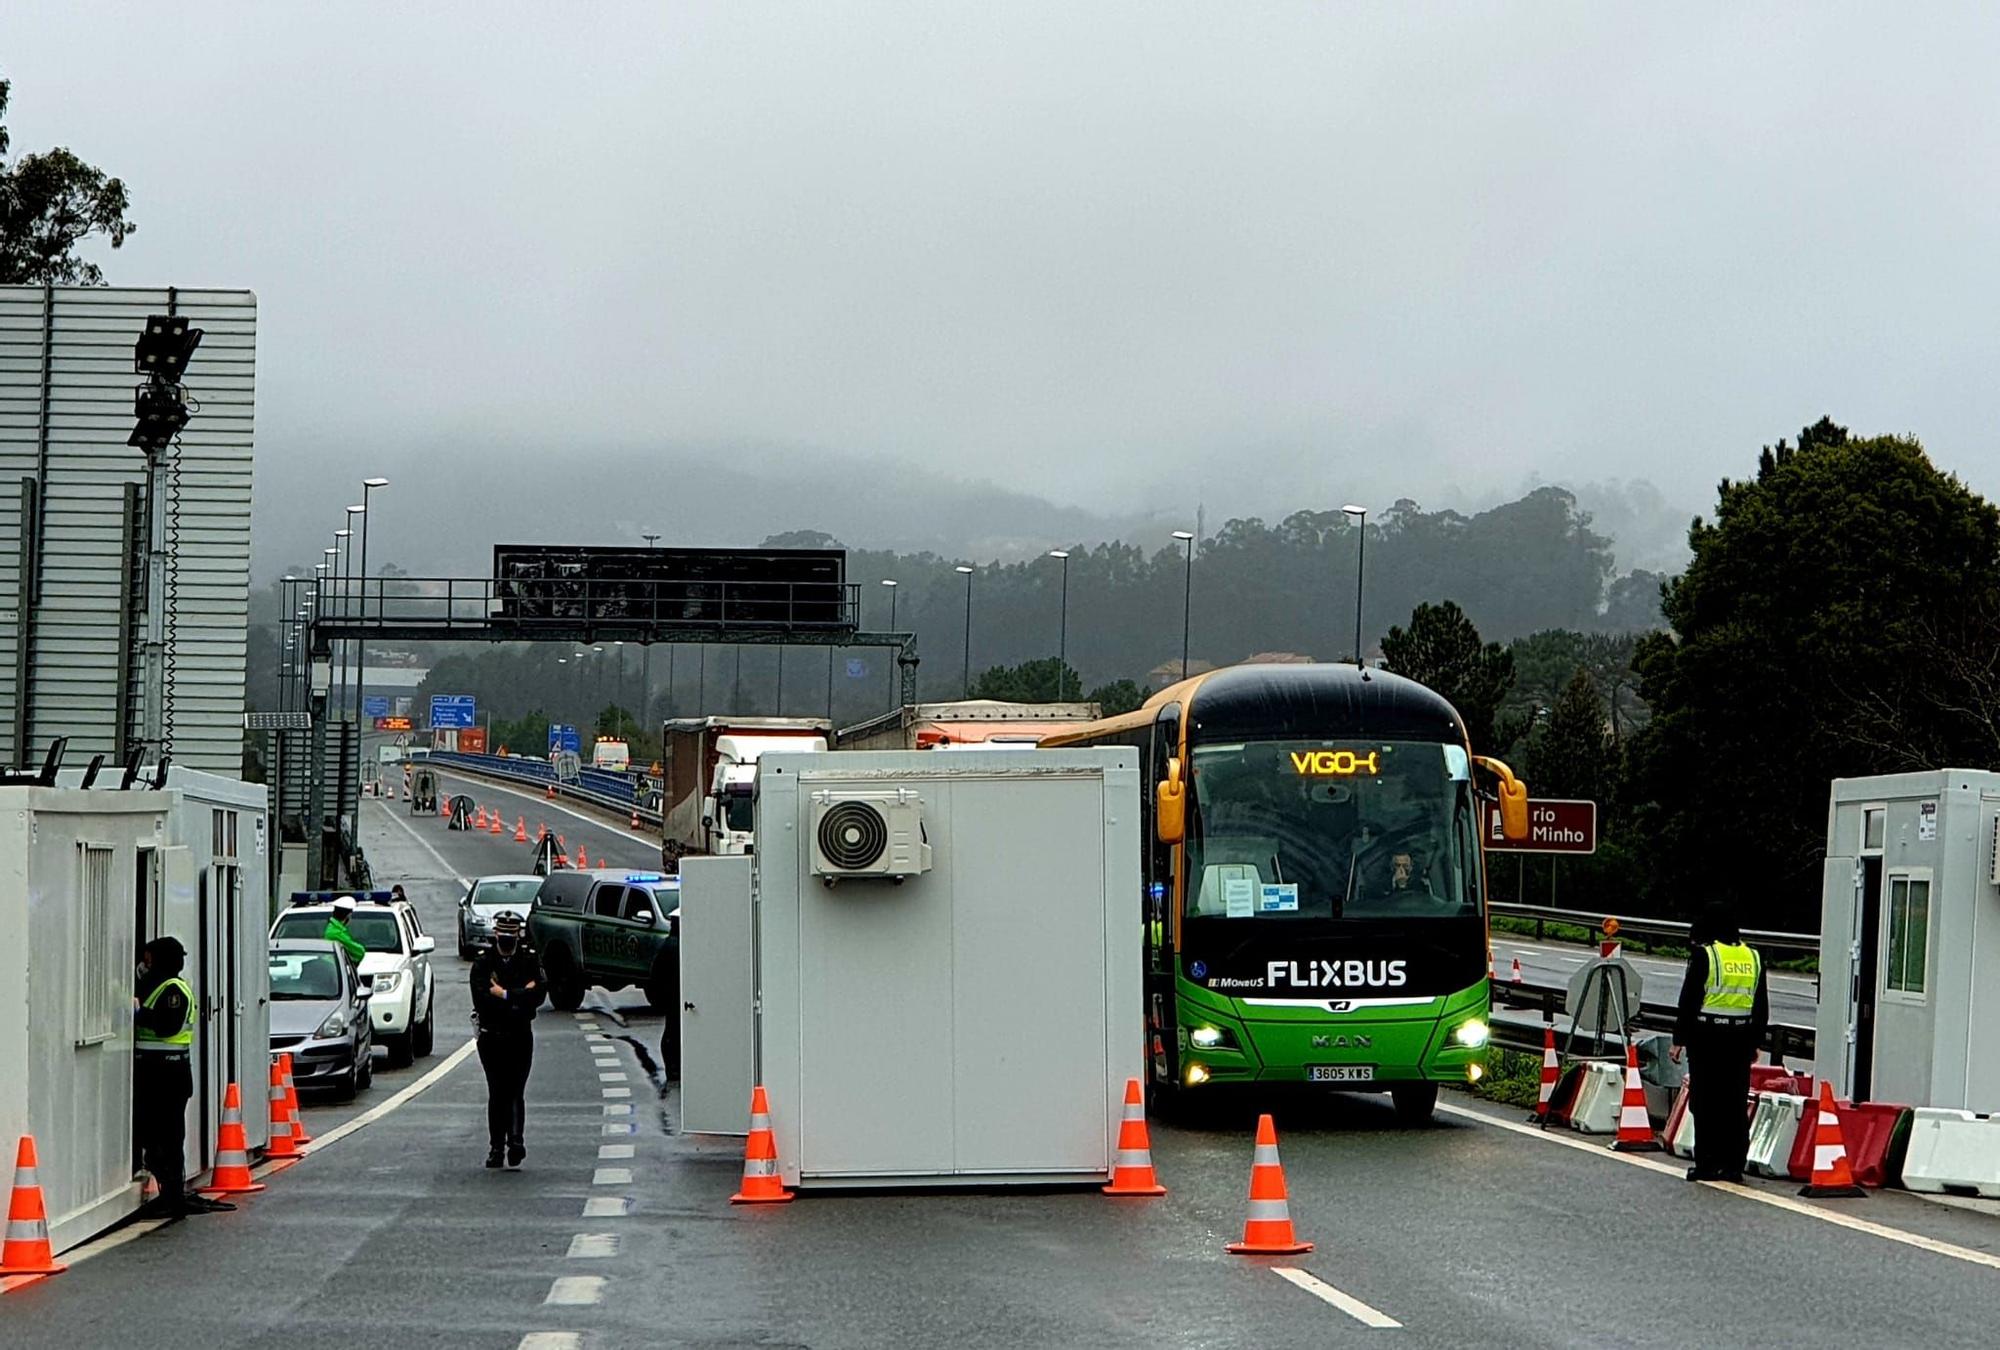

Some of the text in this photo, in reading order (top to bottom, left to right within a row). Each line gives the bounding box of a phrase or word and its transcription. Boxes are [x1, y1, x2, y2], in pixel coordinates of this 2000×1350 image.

[1533, 807, 1556, 822] rio
[1533, 826, 1585, 842] Minho
[1724, 962, 1753, 975] GNR
[1312, 1034, 1372, 1048] MAN
[1316, 1068, 1345, 1080] 3605
